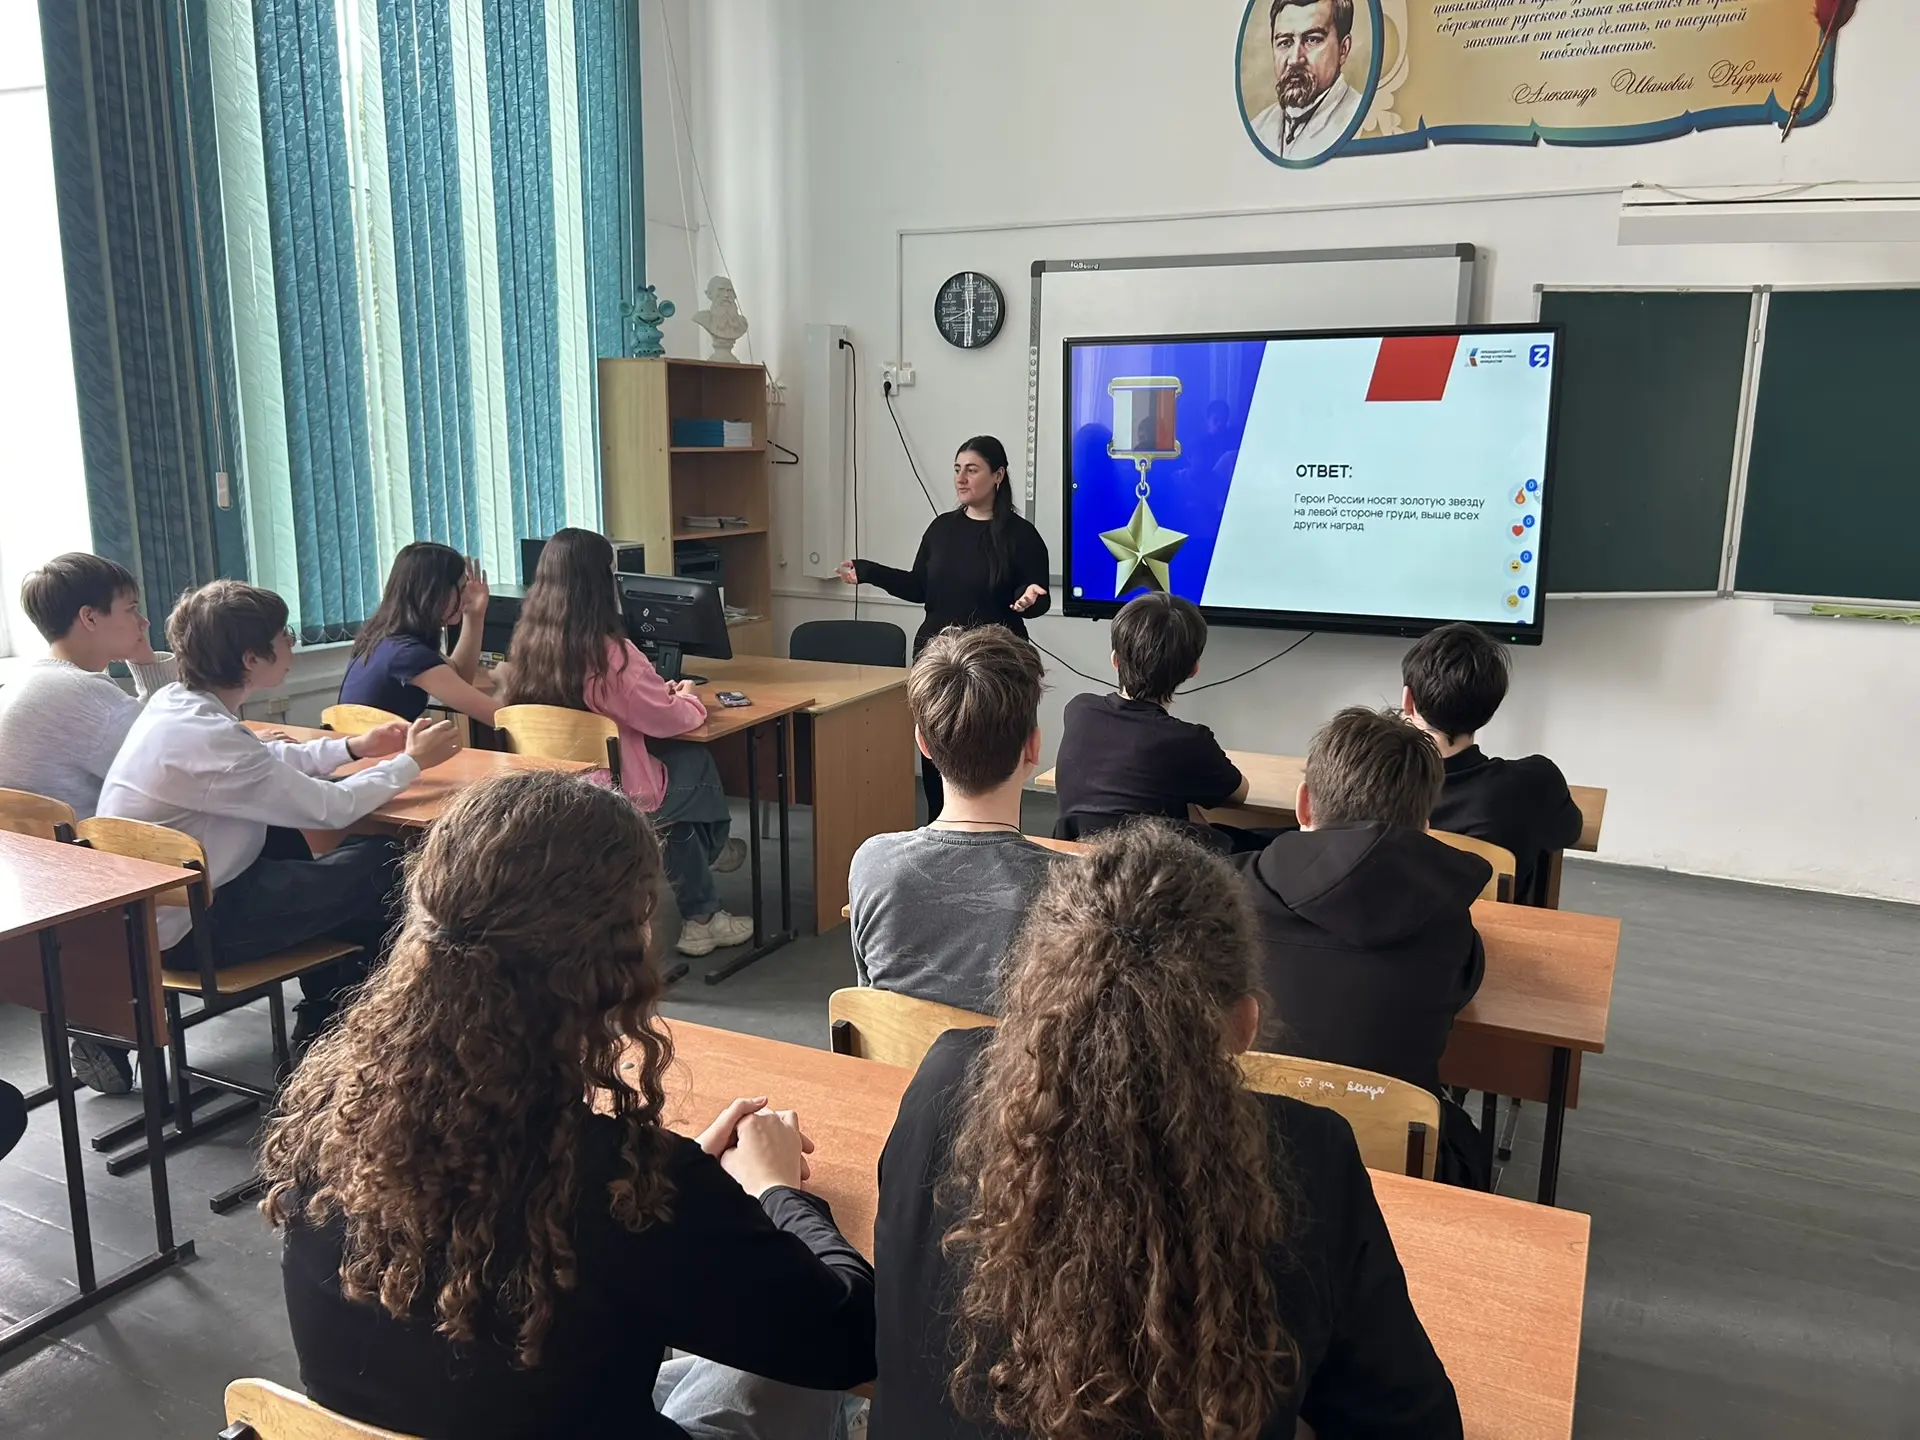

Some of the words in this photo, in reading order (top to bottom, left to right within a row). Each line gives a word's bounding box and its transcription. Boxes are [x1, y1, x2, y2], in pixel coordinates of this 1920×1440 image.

[1436, 16, 1509, 37] сбережение
[1511, 11, 1567, 30] русского
[1570, 4, 1613, 18] языка
[1616, 0, 1683, 14] является
[1463, 33, 1529, 49] занятием
[1533, 30, 1551, 42] от
[1556, 27, 1594, 40] нечего
[1598, 19, 1650, 35] делать,
[1655, 19, 1671, 30] но
[1675, 8, 1748, 32] насущной
[1539, 39, 1656, 60] необходимостью.
[1511, 81, 1598, 108] Александр
[1610, 68, 1695, 96] Иванович
[1708, 59, 1784, 94] Куприн
[1295, 464, 1353, 479] ОТВЕТ:
[1294, 493, 1326, 507] Герои
[1327, 494, 1365, 505] России
[1367, 496, 1398, 505] носят
[1399, 497, 1446, 508] золотую
[1448, 498, 1485, 508] звезду
[1293, 508, 1306, 517] на
[1307, 506, 1338, 517] левой
[1339, 509, 1384, 520] стороне
[1385, 510, 1419, 521] груди,
[1421, 511, 1451, 520] выше
[1453, 511, 1480, 520] всех
[1293, 521, 1328, 532] других
[1329, 521, 1365, 532] наград
